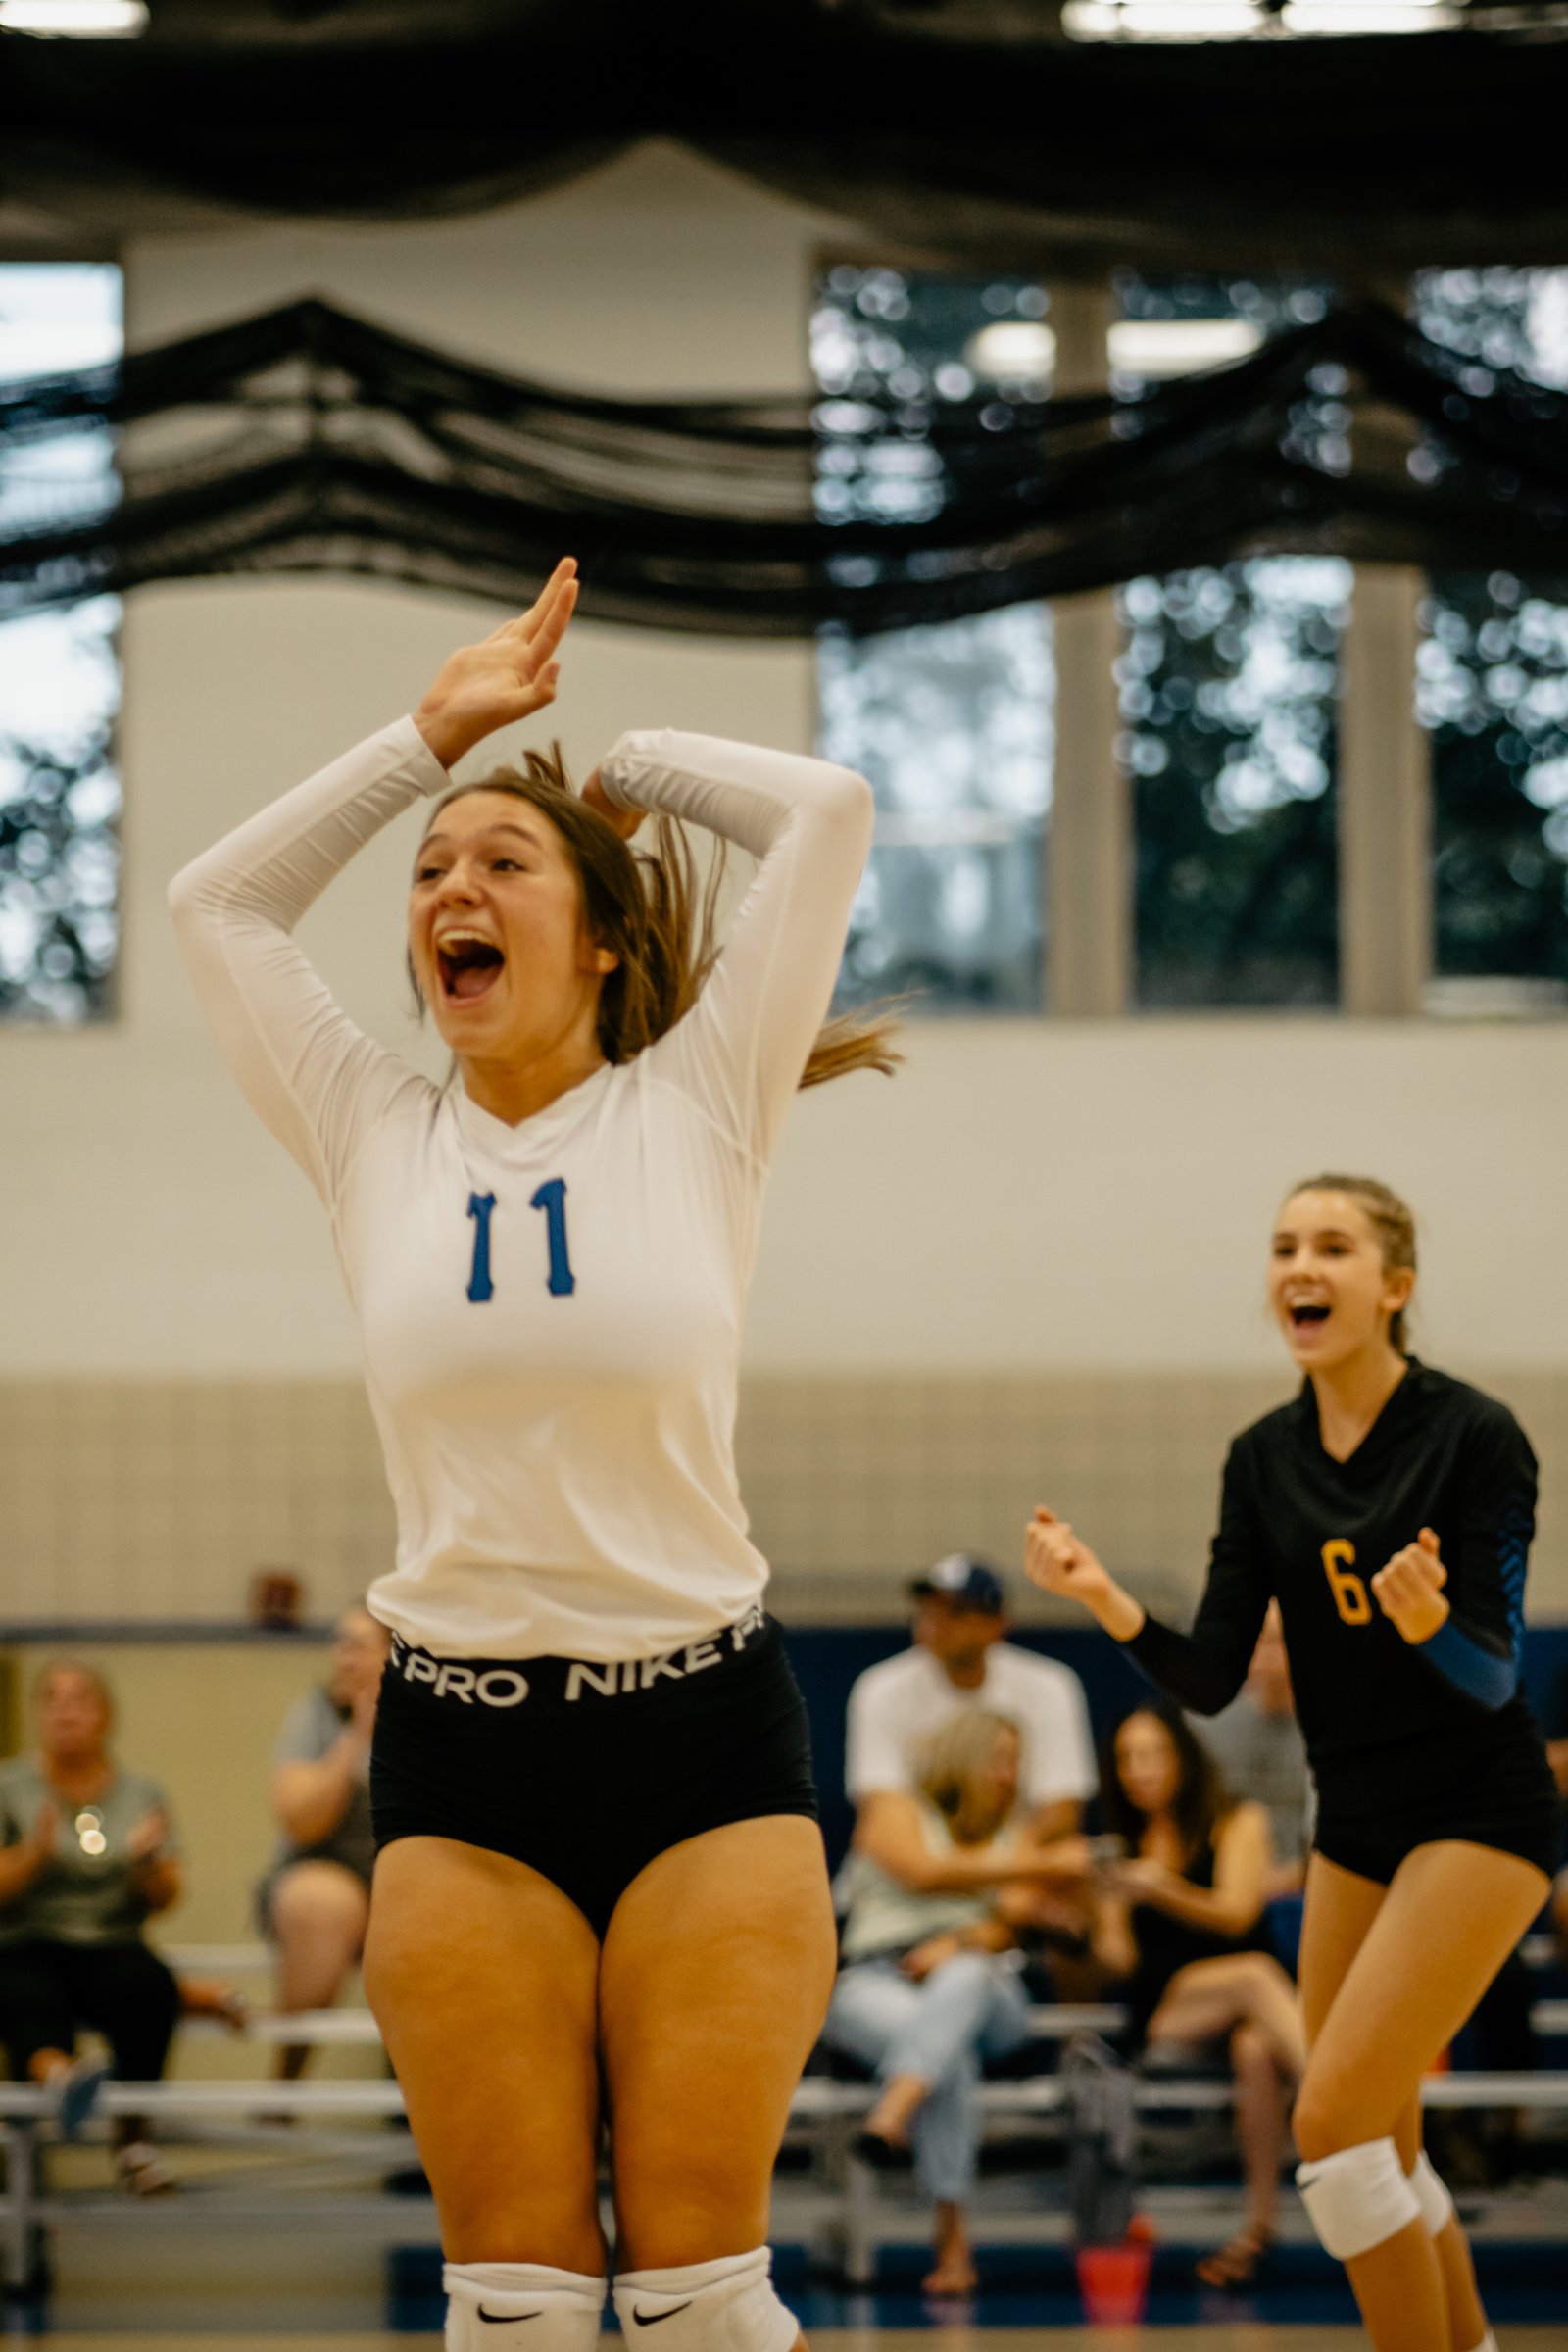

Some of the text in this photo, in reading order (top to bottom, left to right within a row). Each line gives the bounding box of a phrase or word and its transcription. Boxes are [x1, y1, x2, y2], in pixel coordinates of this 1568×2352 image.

[466, 1176, 575, 1302] 11
[1320, 1538, 1372, 1626] 6
[404, 1652, 530, 1708] PRO
[564, 1631, 723, 1701] NIKE
